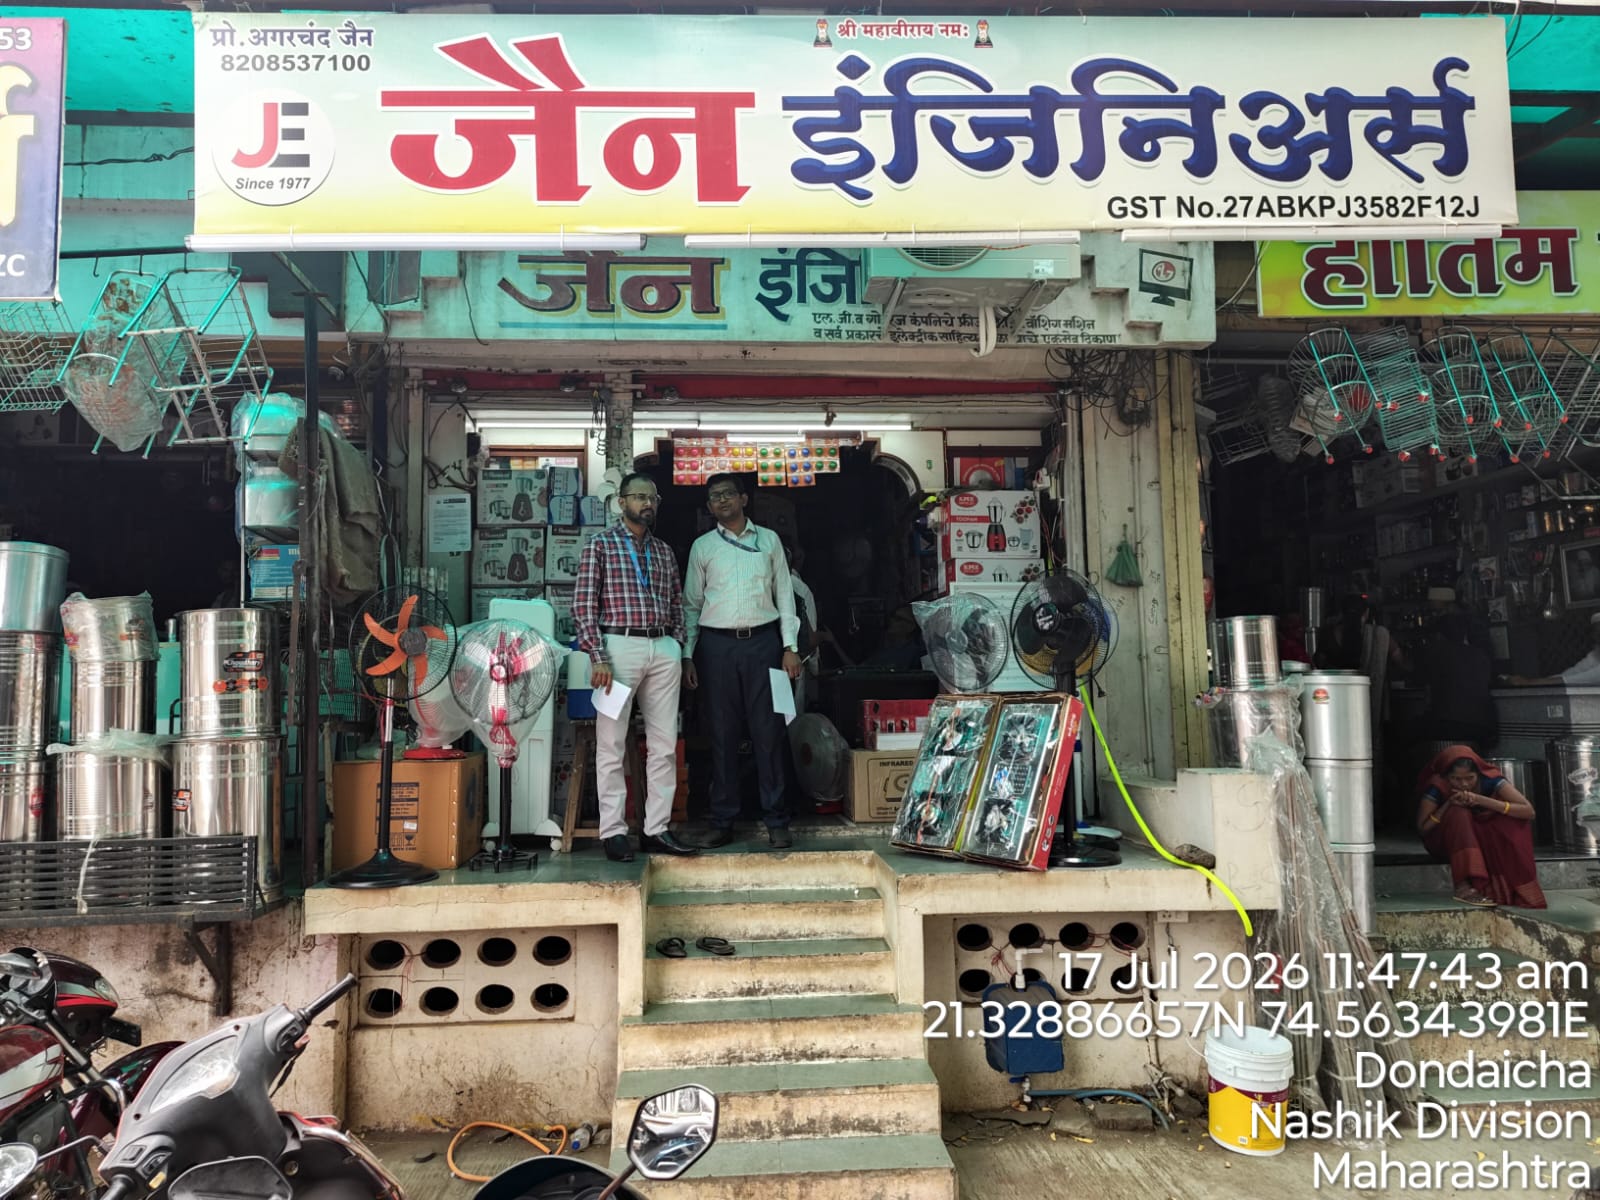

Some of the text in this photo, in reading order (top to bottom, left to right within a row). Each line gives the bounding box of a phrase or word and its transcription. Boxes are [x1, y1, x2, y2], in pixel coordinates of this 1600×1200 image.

[0, 27, 32, 50] 53
[337, 20, 374, 48] जैन
[837, 19, 857, 37] श्री
[860, 19, 934, 39] महावीराय
[220, 54, 371, 72] 8208537100
[380, 36, 1476, 202] जैन इंजिनिअर्स
[231, 102, 311, 169] JE
[235, 176, 311, 190] Since 1977
[1107, 195, 1481, 219] GST No.27ABKPJ3582F12J
